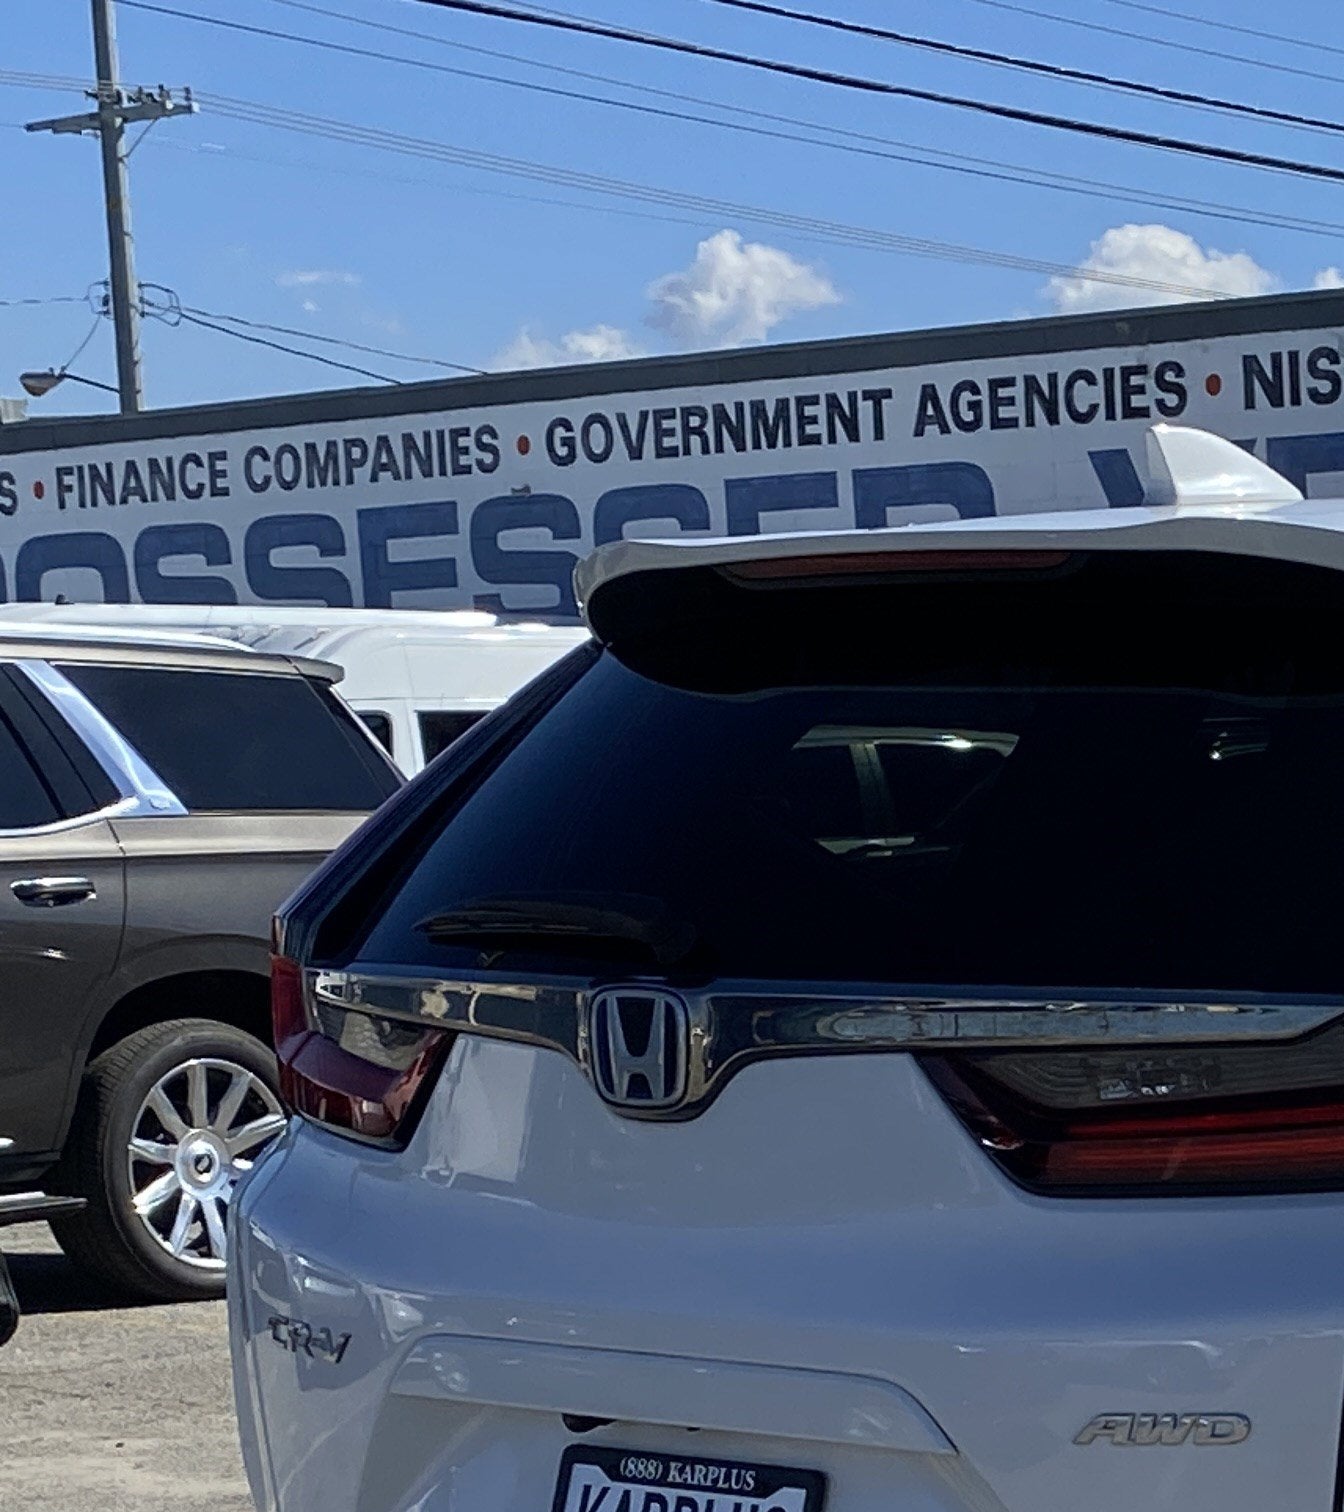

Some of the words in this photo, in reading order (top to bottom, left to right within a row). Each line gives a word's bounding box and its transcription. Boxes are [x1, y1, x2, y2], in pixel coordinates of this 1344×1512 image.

[55, 450, 231, 510] FINANCE
[244, 423, 501, 494] COMPANIES
[545, 387, 893, 467] GOVERNMENT
[913, 359, 1189, 438] AGENCIES
[1071, 1412, 1252, 1446] AWD
[619, 1456, 664, 1480] (888)
[667, 1461, 756, 1491] KARPLUS
